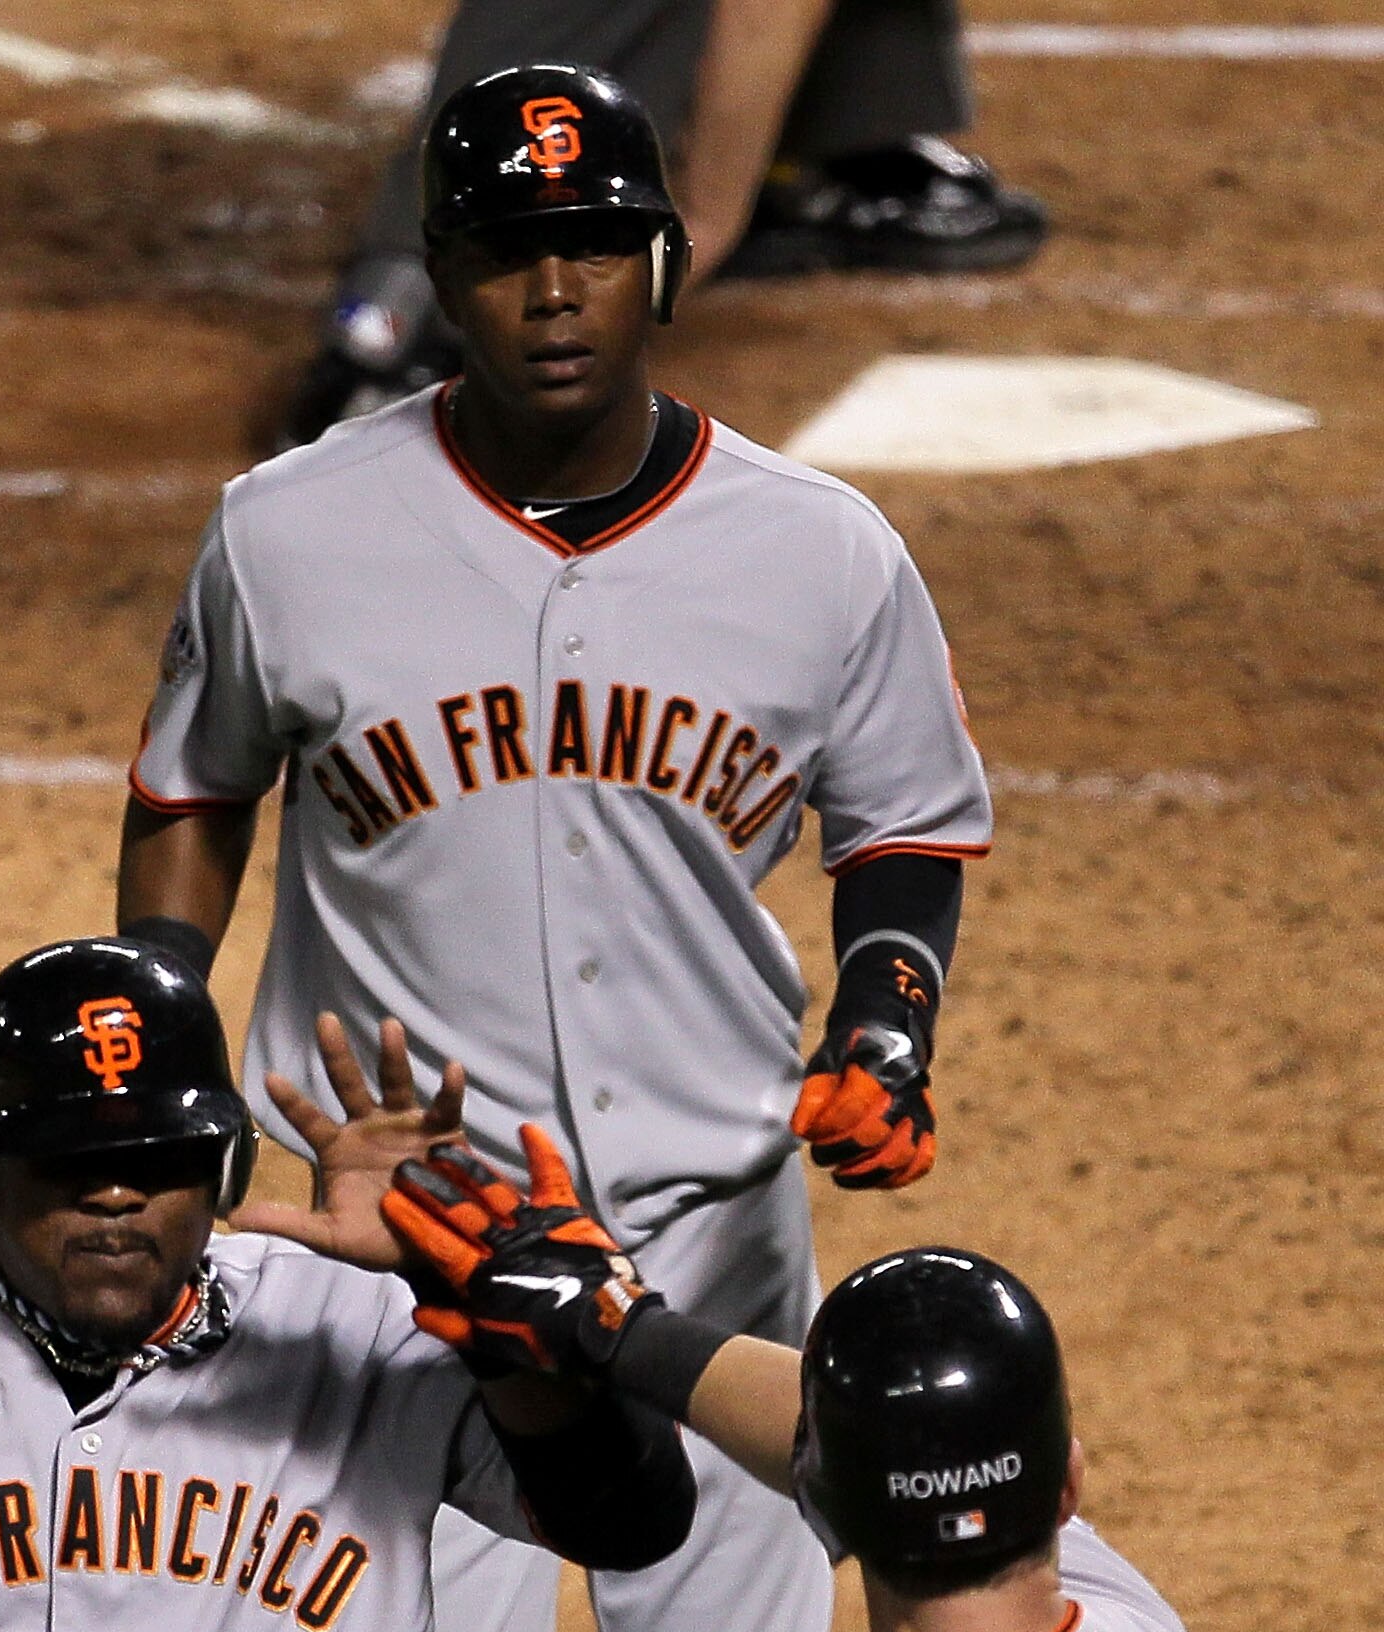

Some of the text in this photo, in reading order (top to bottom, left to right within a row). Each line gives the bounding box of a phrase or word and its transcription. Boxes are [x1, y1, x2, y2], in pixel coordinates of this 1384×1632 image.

[311, 679, 802, 854] SAN FRANCISCO
[888, 1450, 1023, 1499] ROWAND
